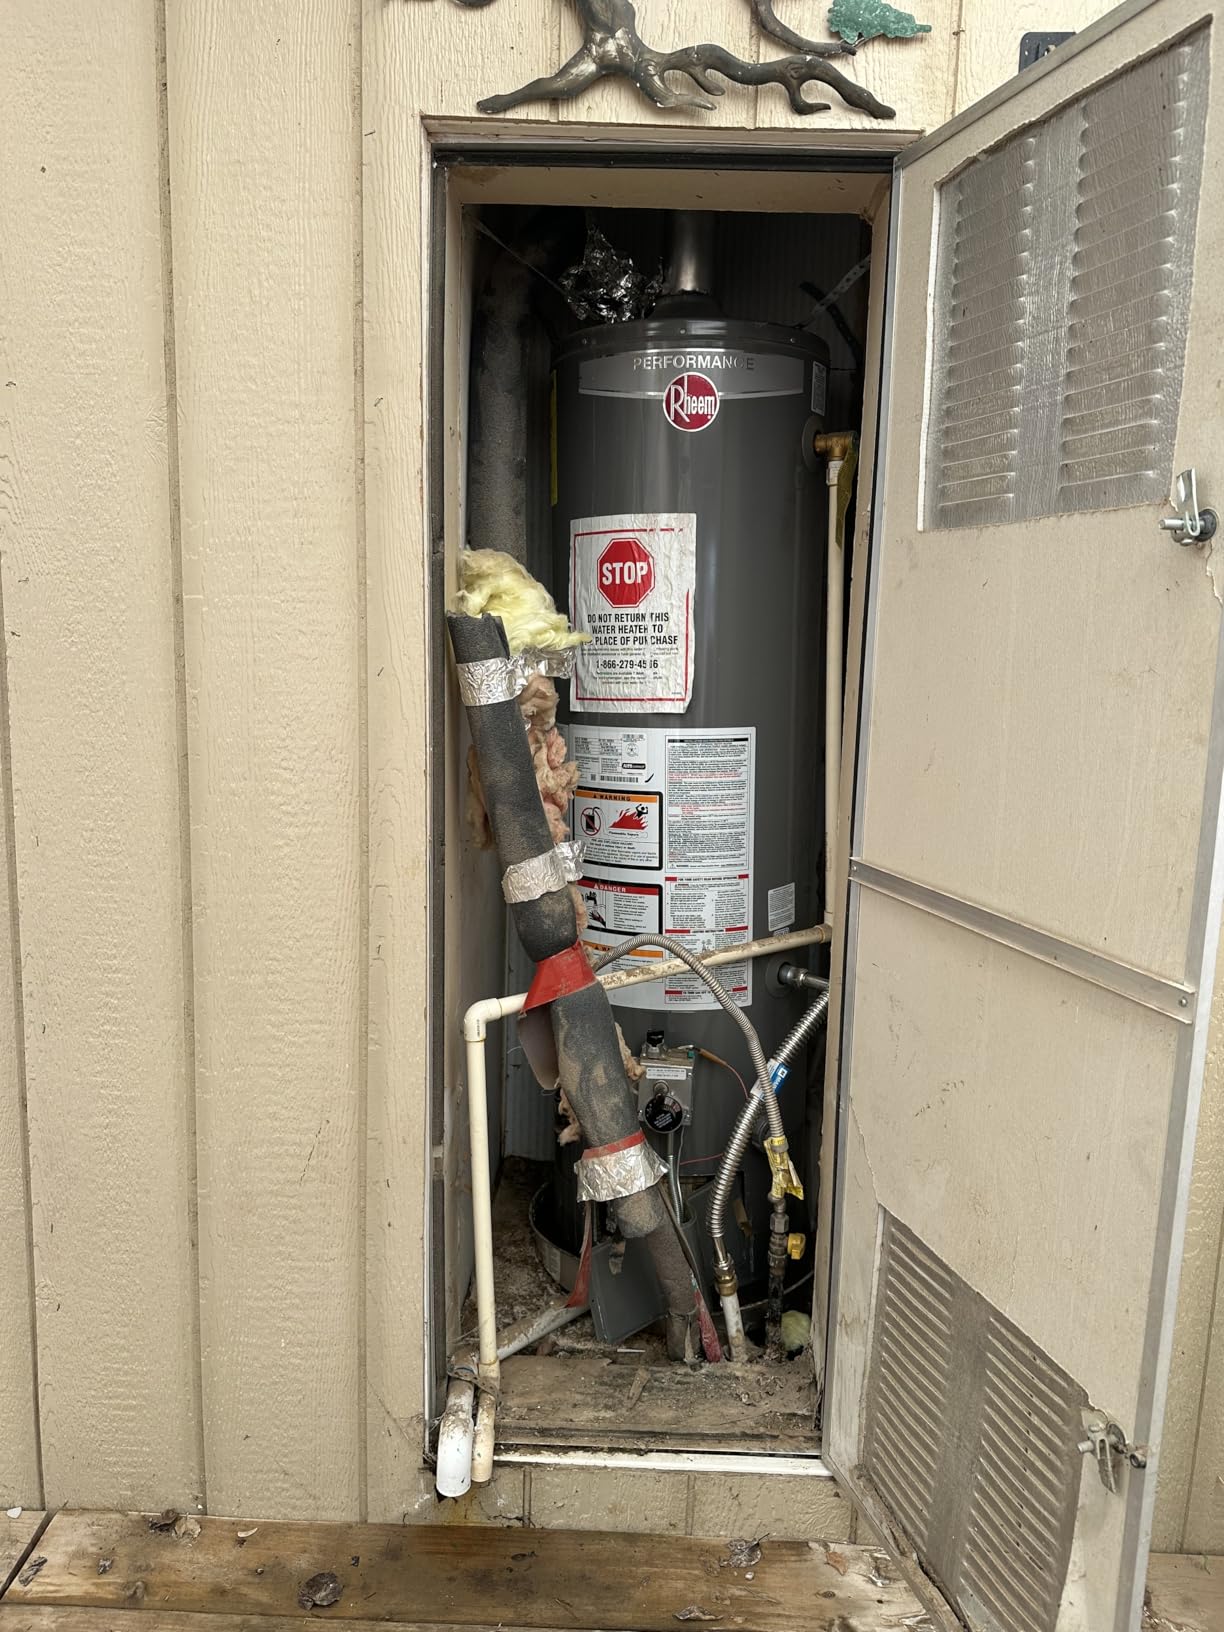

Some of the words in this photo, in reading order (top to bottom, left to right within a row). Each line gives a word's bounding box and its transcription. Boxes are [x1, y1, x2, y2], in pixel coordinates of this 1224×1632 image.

[633, 354, 756, 370] PERFORMANCE
[670, 375, 714, 422] Rheem
[602, 561, 648, 585] STOP
[588, 614, 596, 623] DO
[599, 614, 612, 623] NOT
[615, 613, 646, 623] RETURN
[650, 612, 669, 622] THIS
[592, 625, 615, 634] WATER
[652, 624, 663, 633] TO
[596, 636, 617, 645] PLACE
[621, 636, 630, 645] OF
